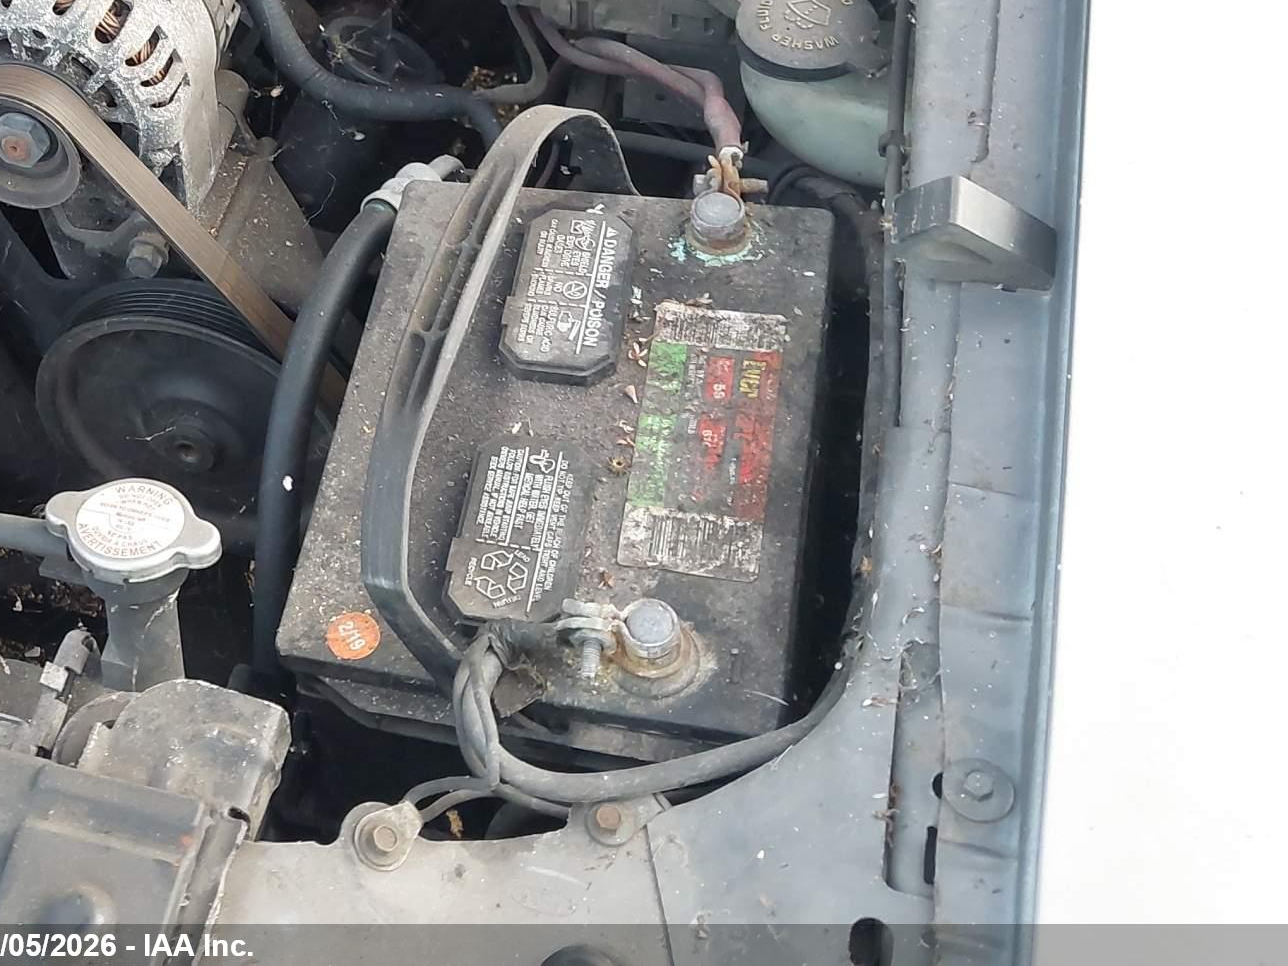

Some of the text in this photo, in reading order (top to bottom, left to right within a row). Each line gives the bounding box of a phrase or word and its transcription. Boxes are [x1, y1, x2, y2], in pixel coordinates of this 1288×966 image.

[771, 33, 840, 50] WASHER
[570, 250, 581, 266] EYES
[552, 281, 562, 292] NO
[582, 238, 617, 347] DANGER / POISON
[540, 336, 551, 353] ACID
[559, 460, 568, 469] DO
[557, 470, 566, 483] NOT
[115, 485, 174, 505] WARNING
[538, 494, 549, 509] EYES
[561, 490, 571, 502] OUT
[516, 497, 528, 513] HELP
[559, 504, 568, 513] OF
[513, 513, 525, 529] FAST
[524, 511, 535, 523] GET
[79, 523, 164, 556] AVERTISSEMENT
[465, 556, 477, 586] RECYCLE
[338, 620, 366, 650] 2/19
